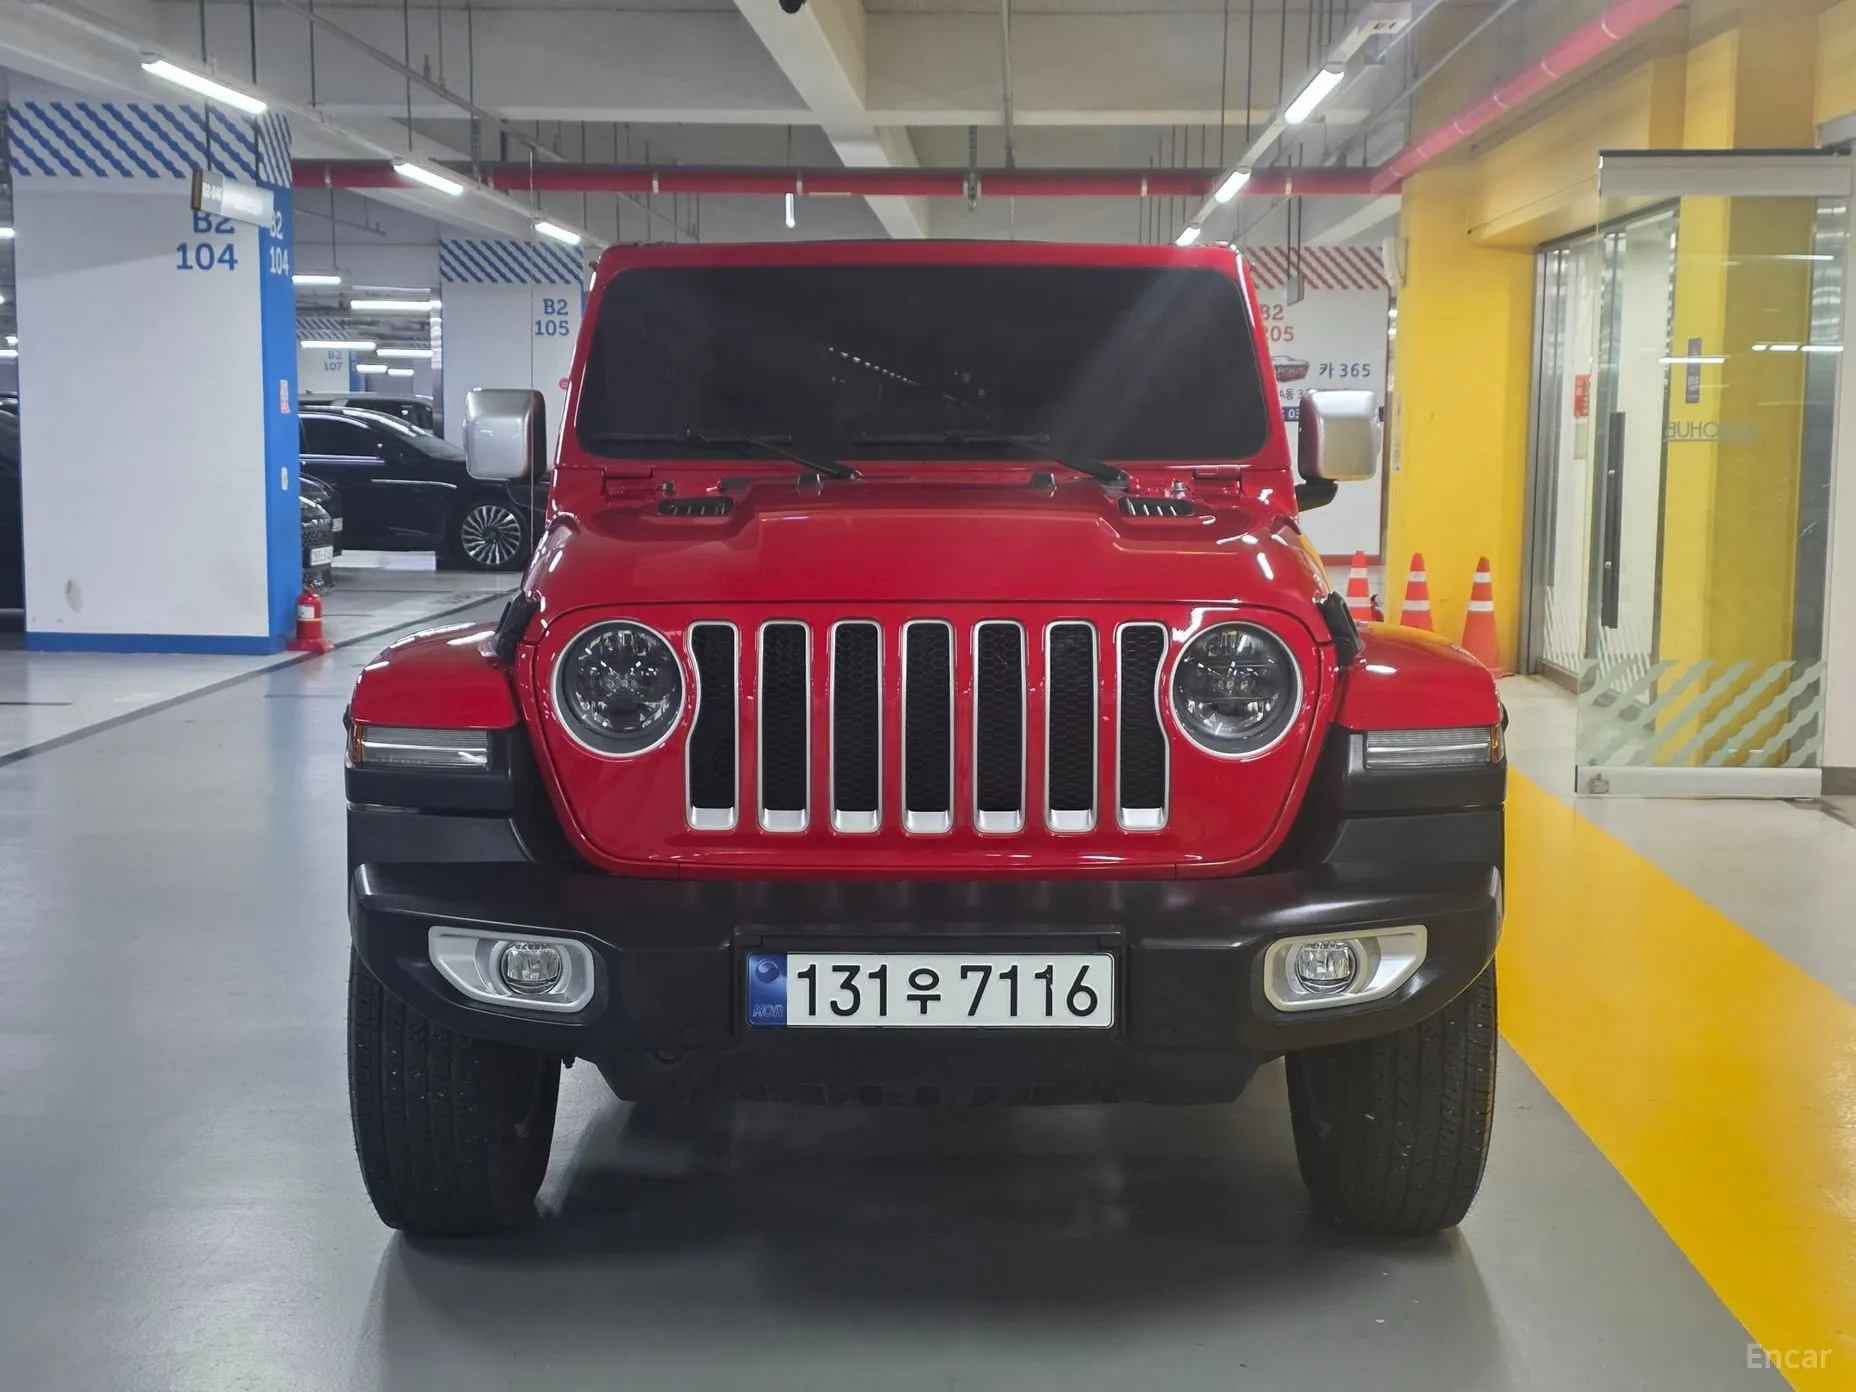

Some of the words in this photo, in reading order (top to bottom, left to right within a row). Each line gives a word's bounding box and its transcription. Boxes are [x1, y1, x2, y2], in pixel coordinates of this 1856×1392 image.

[193, 212, 235, 234] B2
[176, 242, 238, 270] 104
[270, 246, 290, 276] 104
[543, 298, 569, 316] B2
[534, 320, 570, 336] 105
[1265, 326, 1294, 342] 05
[328, 350, 343, 360] B2
[324, 361, 343, 372] 107
[1319, 362, 1335, 379] 카
[1339, 363, 1371, 378] 365
[797, 964, 941, 1017] 131우
[960, 964, 1098, 1017] 7116
[752, 1003, 784, 1018] KOR
